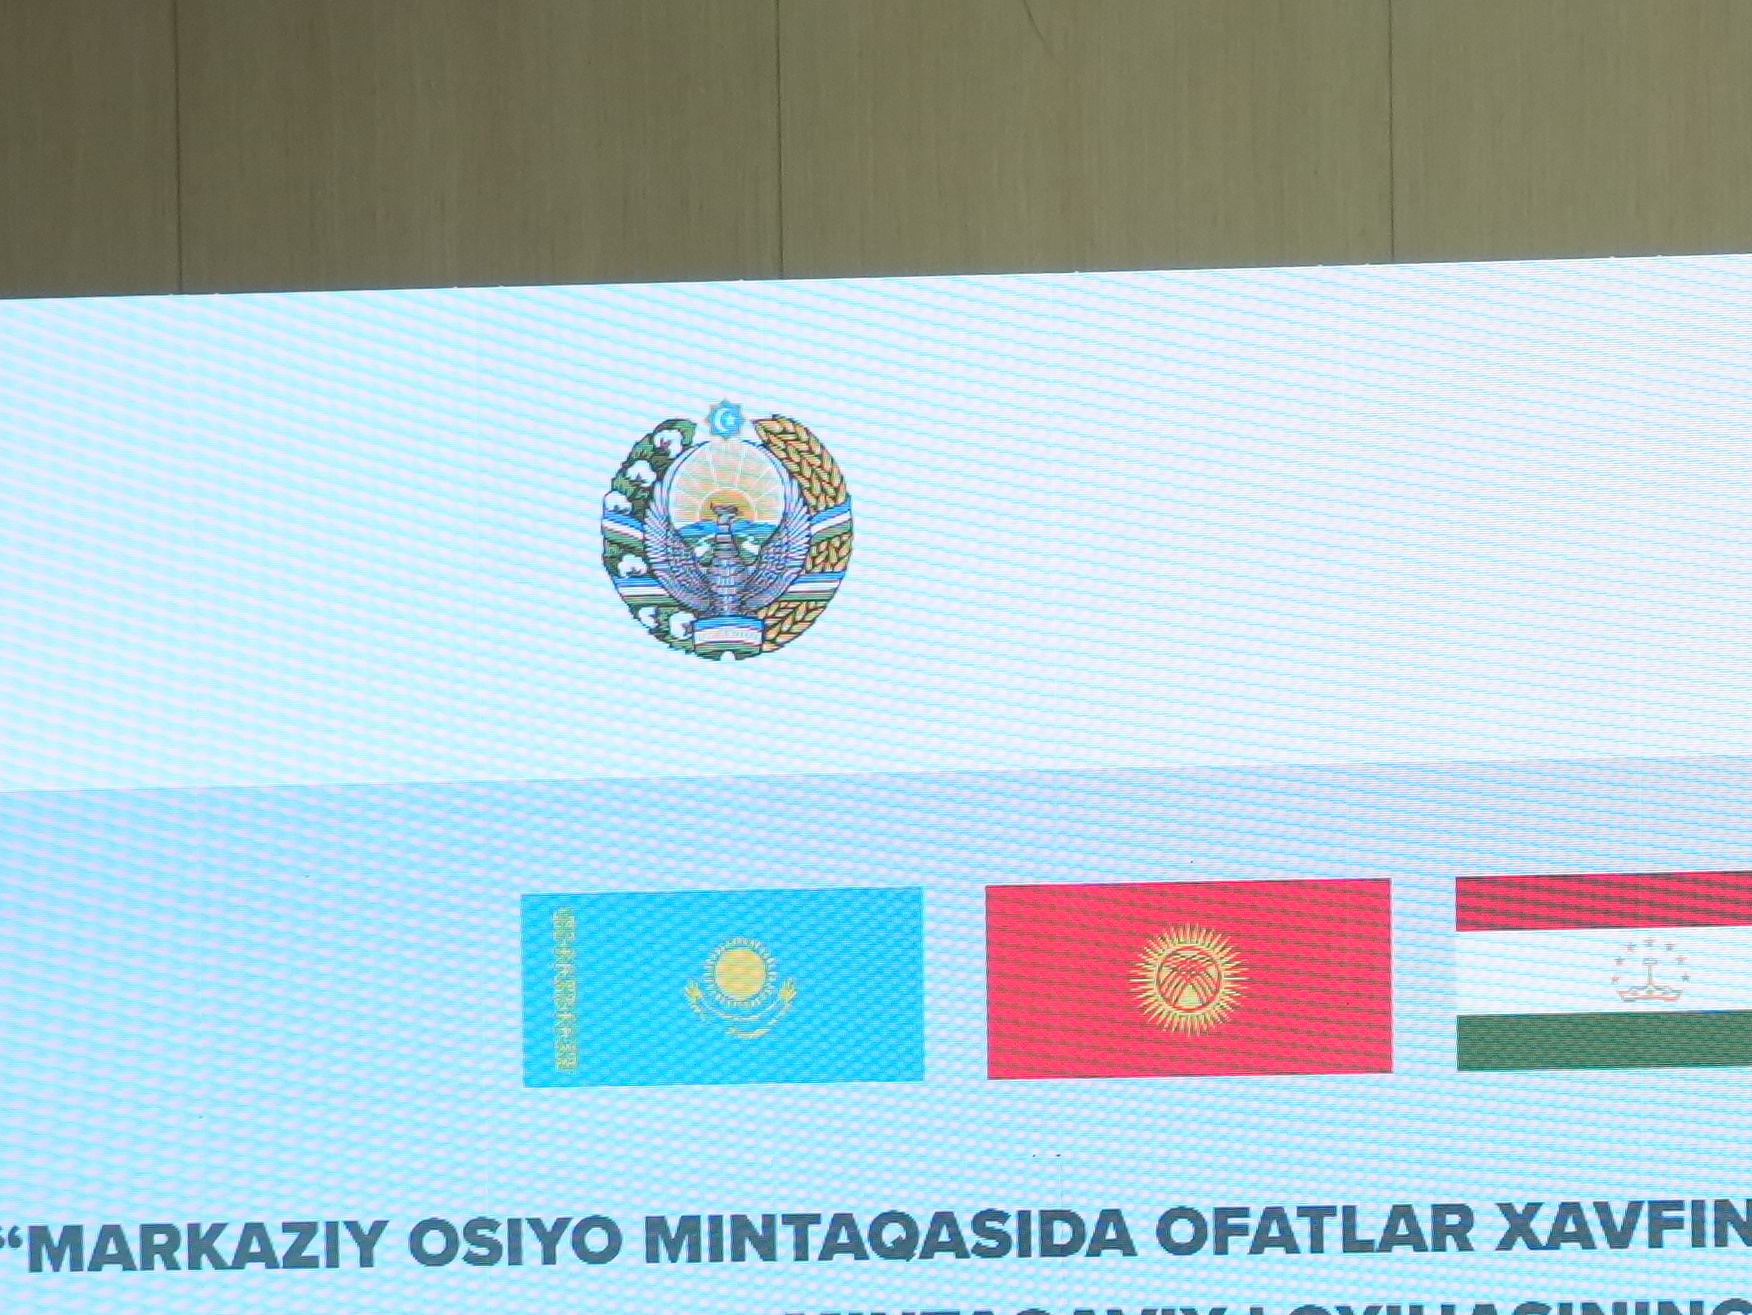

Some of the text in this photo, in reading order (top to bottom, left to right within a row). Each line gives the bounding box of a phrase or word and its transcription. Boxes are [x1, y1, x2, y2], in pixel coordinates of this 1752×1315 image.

[407, 1214, 624, 1268] OSIYO
[644, 1208, 1137, 1264] MINTAQASIDA
[1155, 1203, 1475, 1257] OFATLAR
